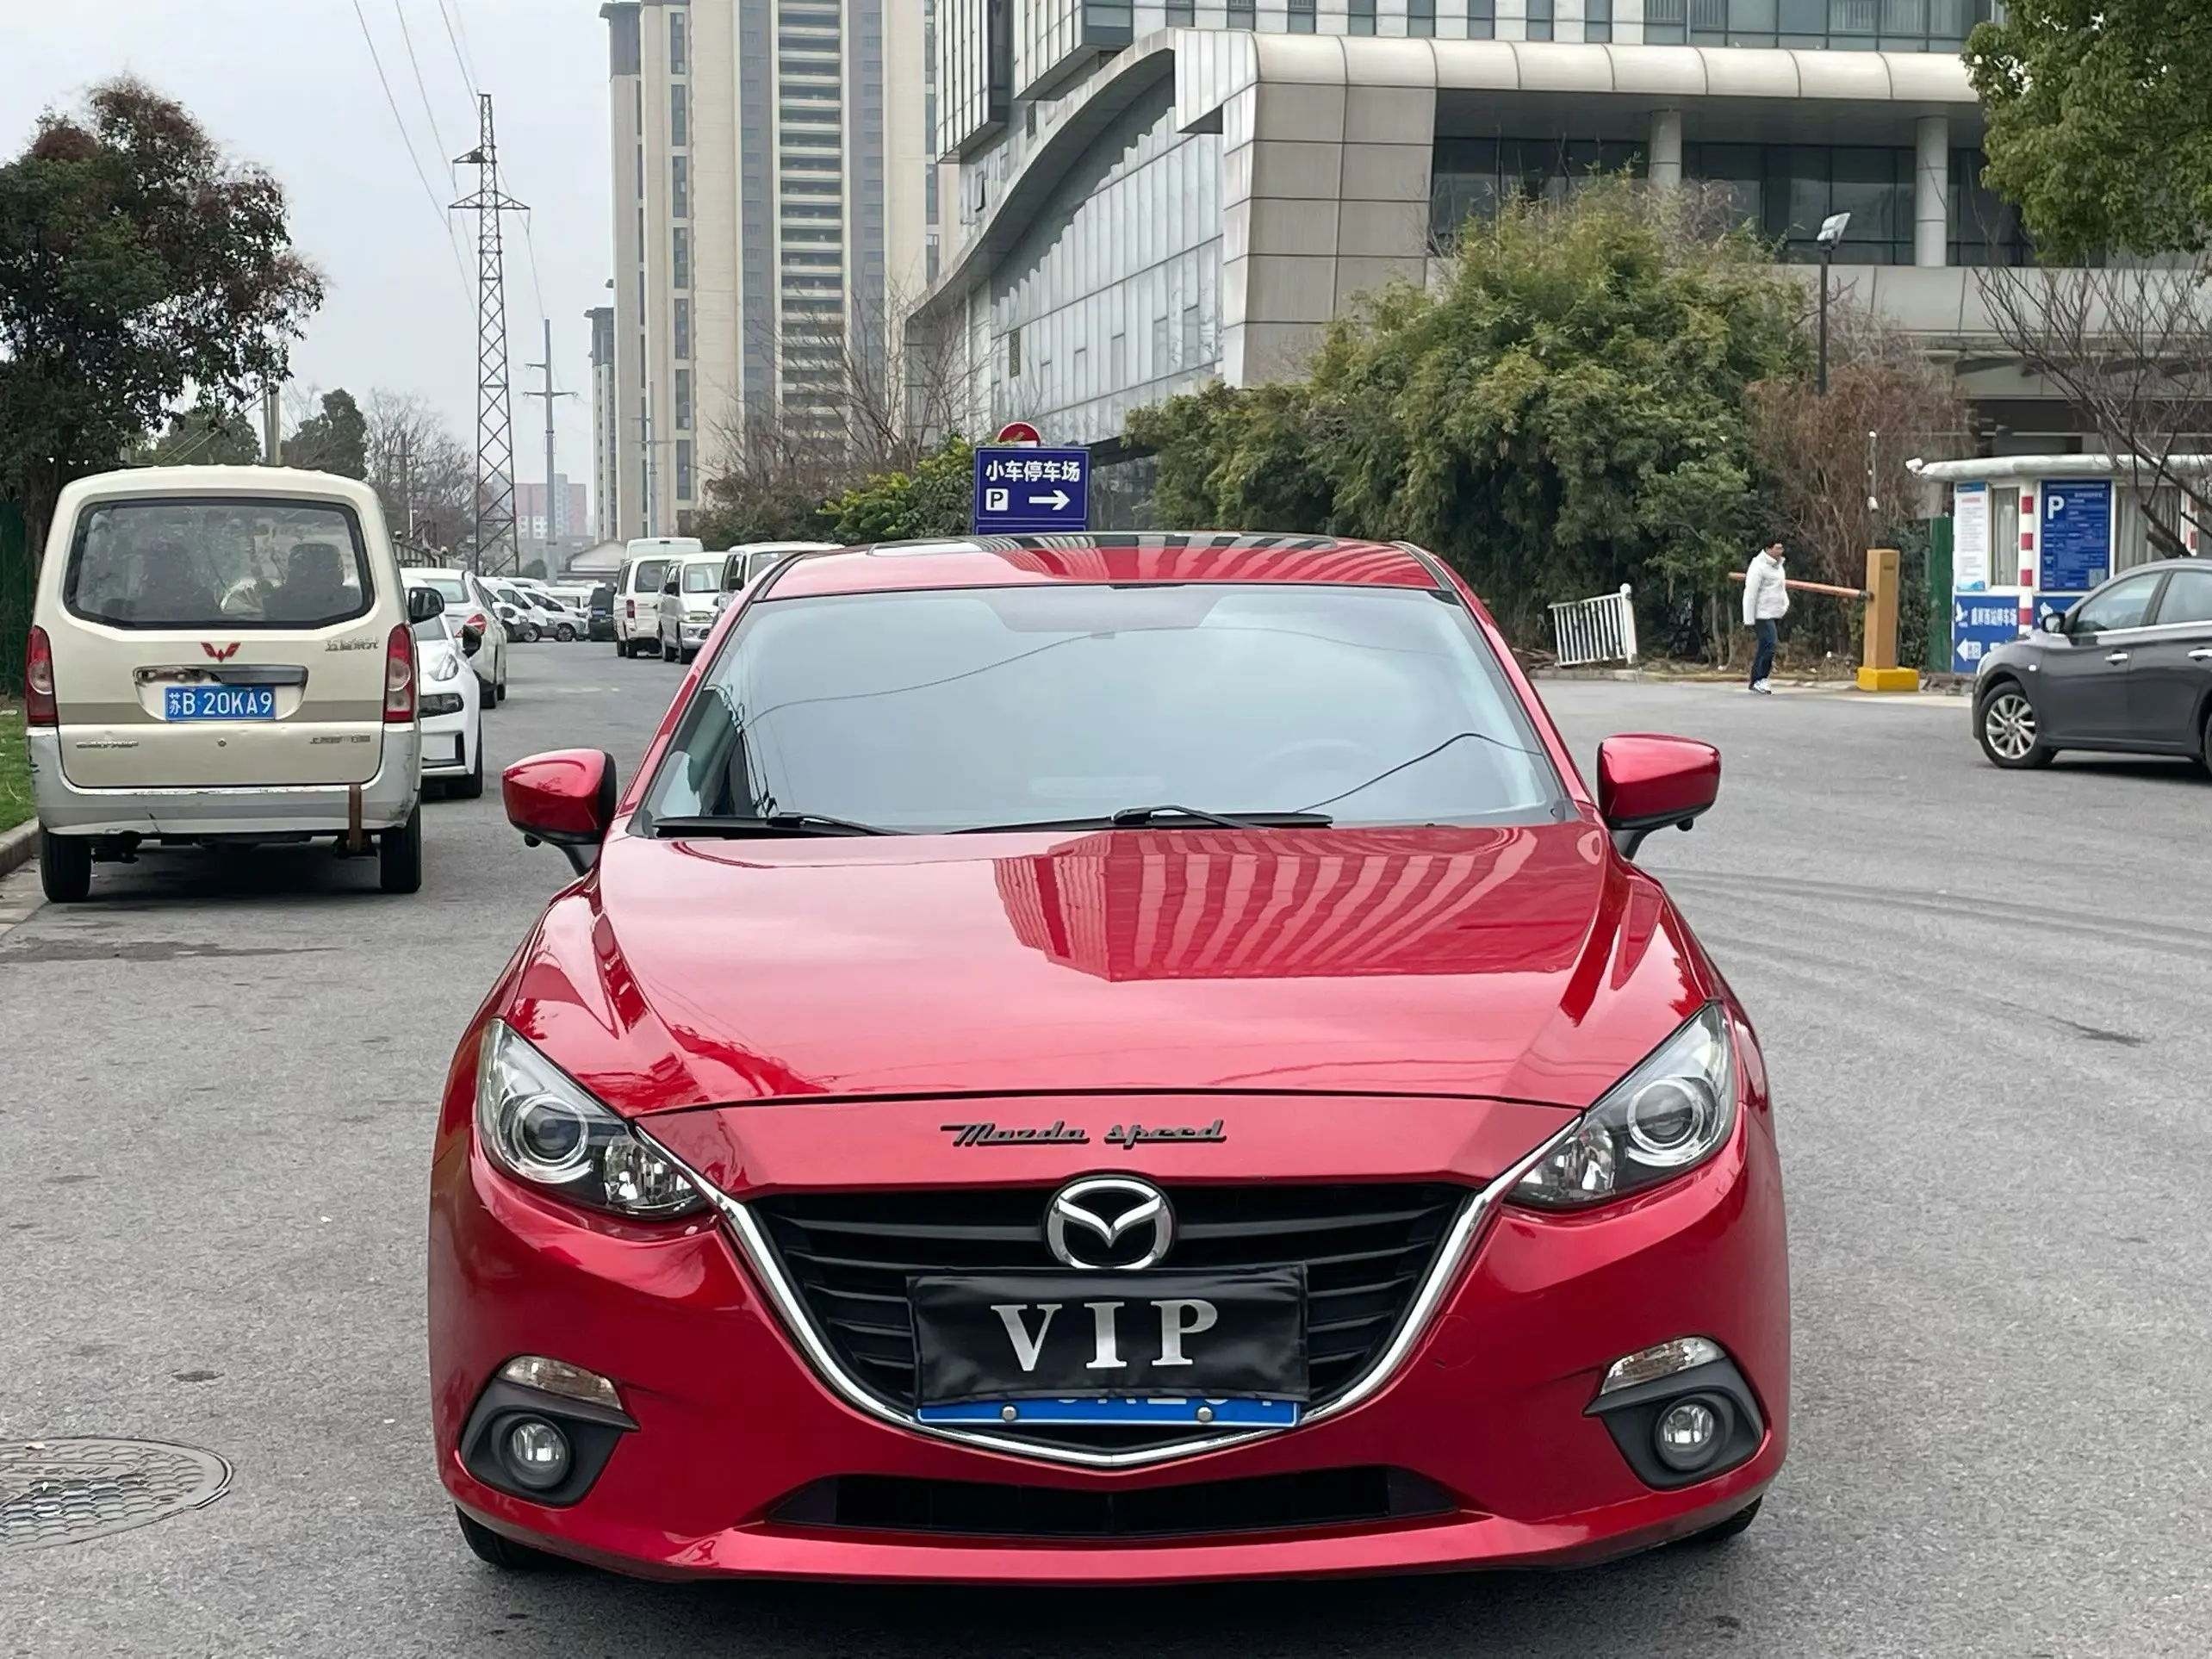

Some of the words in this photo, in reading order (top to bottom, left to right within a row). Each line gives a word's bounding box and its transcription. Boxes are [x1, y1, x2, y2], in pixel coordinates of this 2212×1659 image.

[985, 459, 1081, 482] 小车停车场
[990, 491, 1004, 508] P
[2047, 495, 2065, 519] P
[941, 1121, 1090, 1146] Mazda
[1104, 1120, 1227, 1149] speed
[991, 1299, 1219, 1372] VIP
